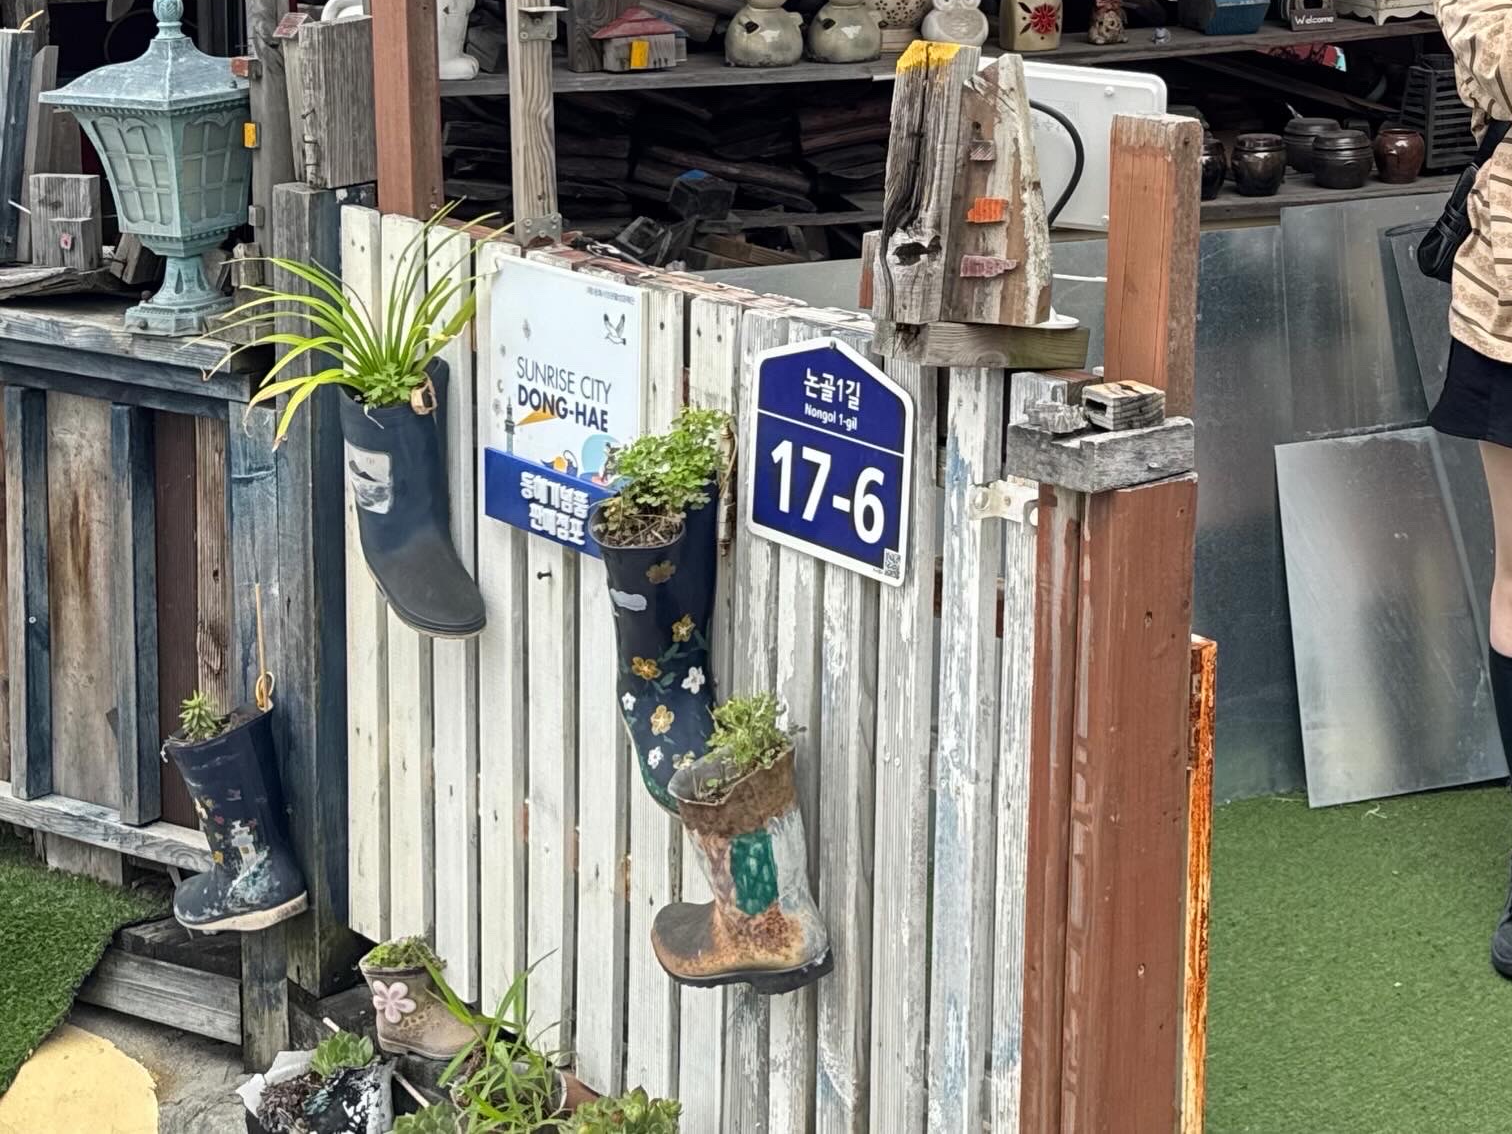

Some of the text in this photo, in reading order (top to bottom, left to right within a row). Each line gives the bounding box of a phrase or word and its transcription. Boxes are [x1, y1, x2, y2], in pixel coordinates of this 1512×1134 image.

[1295, 15, 1334, 25] Welcome
[517, 356, 612, 404] SUNRISE CITY
[803, 367, 861, 411] 논골1길
[518, 384, 608, 433] DONG-HAE
[804, 402, 858, 431] Nongol 1-gil
[520, 471, 589, 519] 동해기념품
[771, 440, 885, 544] 17-6
[529, 503, 585, 545] 판매점포
